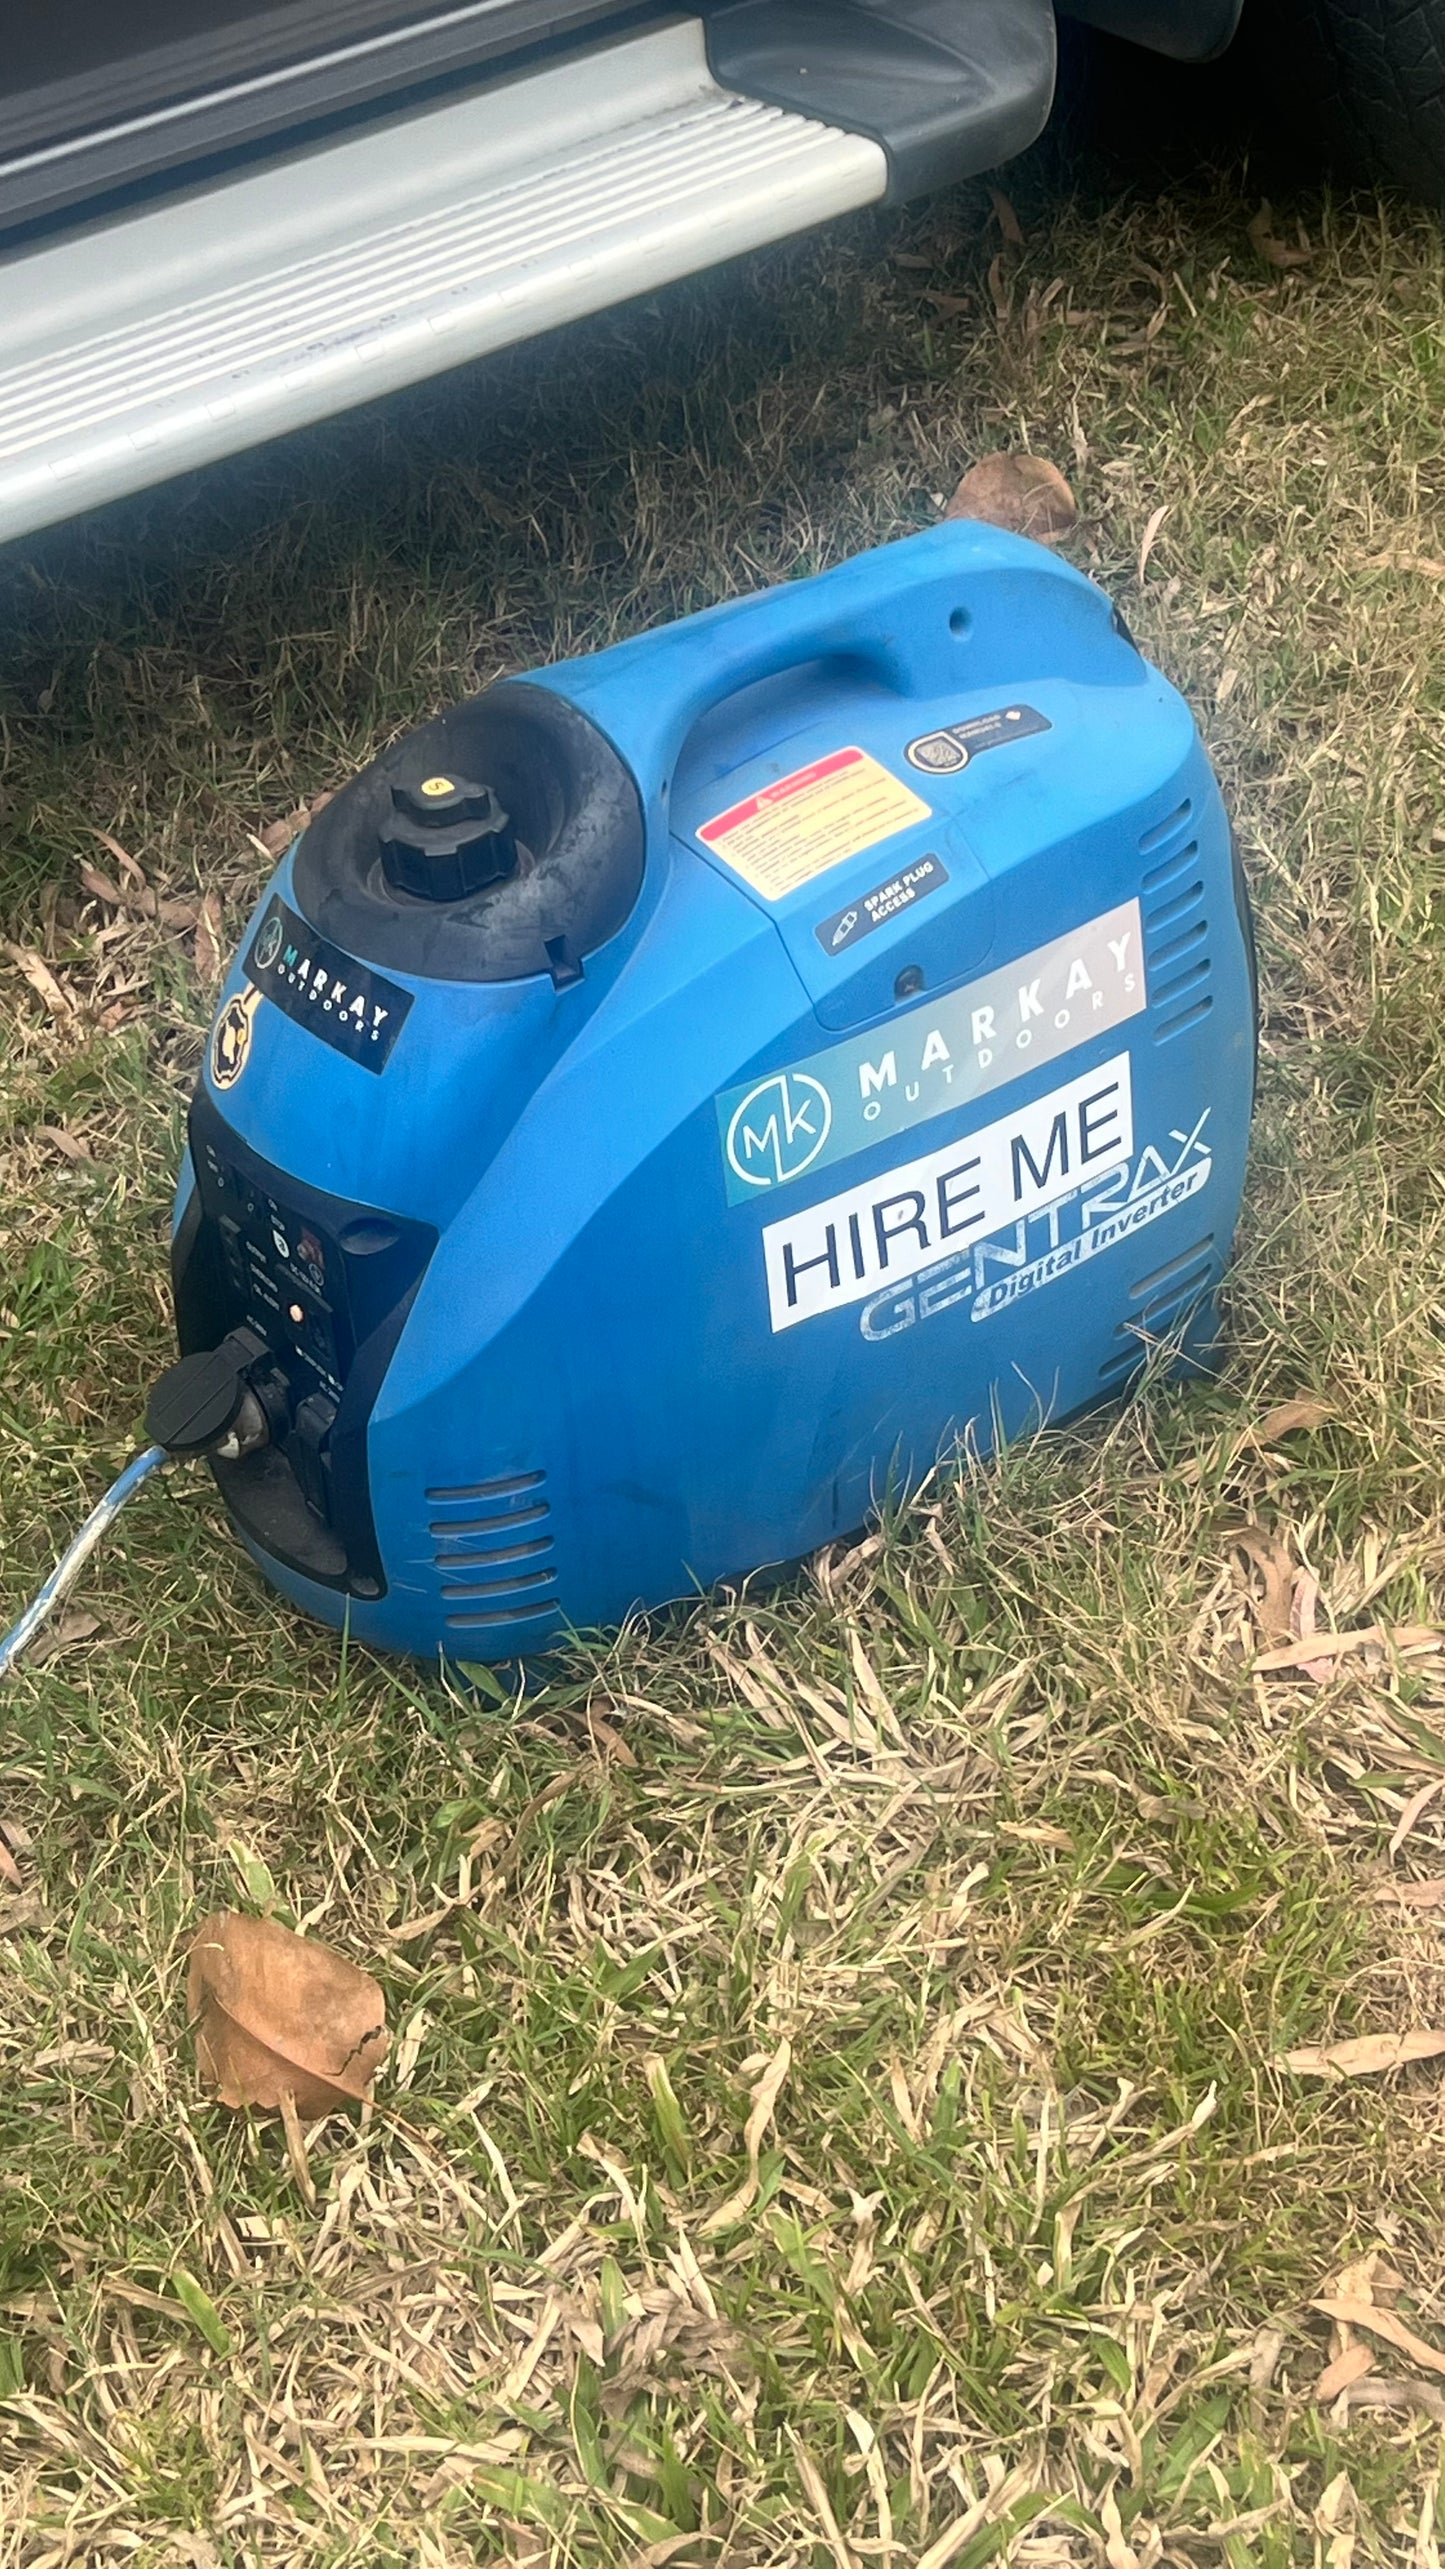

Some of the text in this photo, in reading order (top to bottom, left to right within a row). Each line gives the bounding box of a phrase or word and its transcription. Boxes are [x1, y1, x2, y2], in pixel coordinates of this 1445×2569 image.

[864, 861, 934, 911] SPARK PLUG
[871, 887, 916, 922] ACCESS
[277, 963, 380, 1041] OUTDOORS
[282, 943, 389, 1027] MARKAY
[858, 932, 1131, 1098] MARKAY
[863, 973, 1137, 1121] OUTDOORS
[781, 1081, 1122, 1308] HIRE ME
[859, 1106, 1213, 1342] GENTRAX
[987, 1170, 1198, 1307] Digital Inverter
